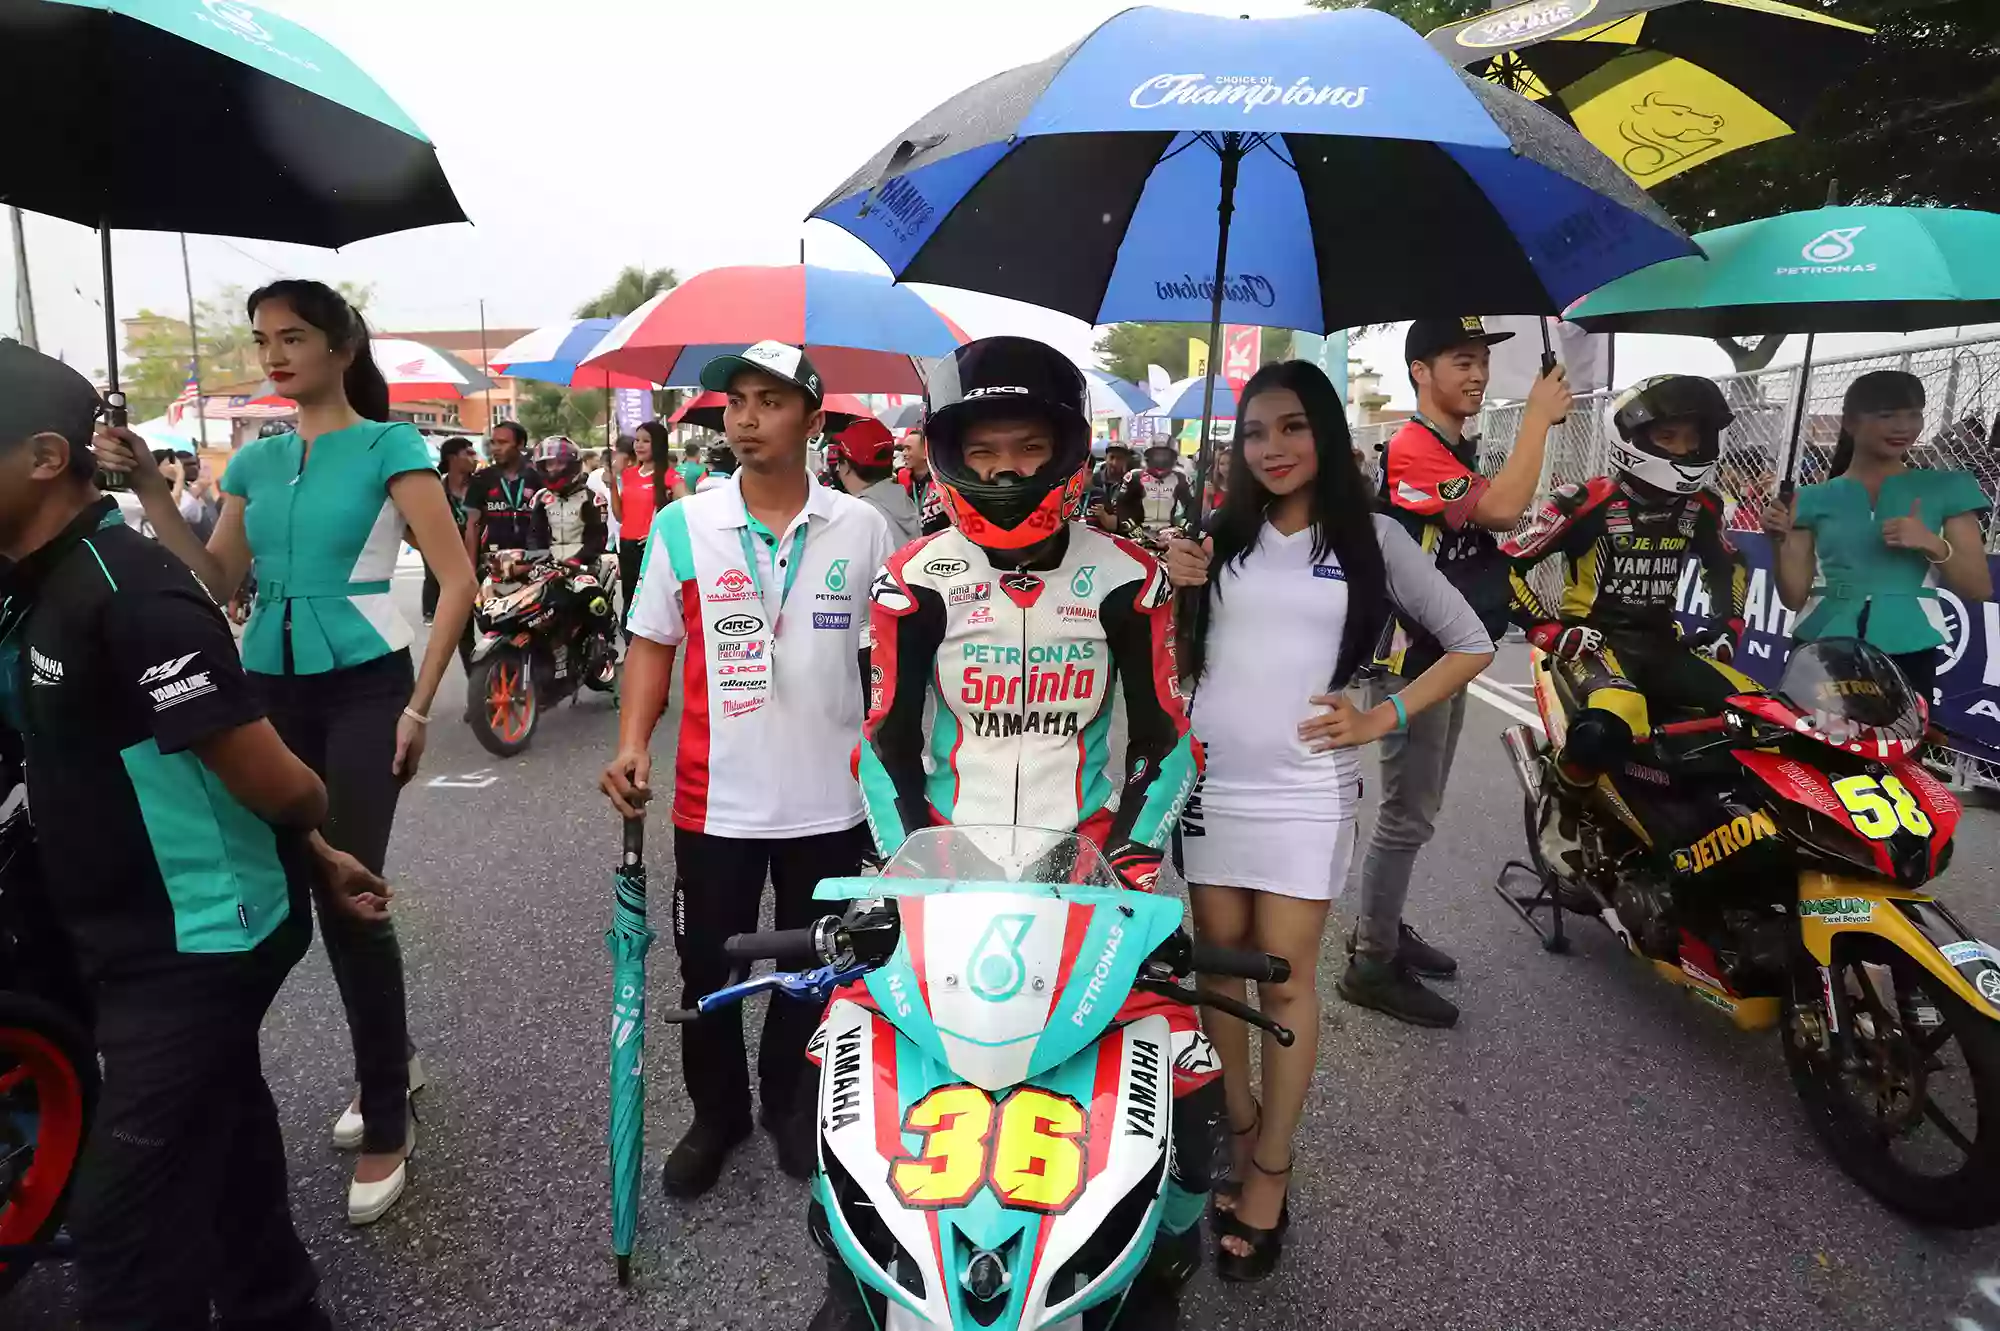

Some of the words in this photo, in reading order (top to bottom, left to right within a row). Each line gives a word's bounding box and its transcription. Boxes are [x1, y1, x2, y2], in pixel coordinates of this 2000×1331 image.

[1215, 76, 1257, 84] CHOICE
[1129, 73, 1369, 114] Champions
[1775, 263, 1877, 275] PETRONAS
[986, 385, 1029, 395] RCB
[930, 562, 961, 571] ARC
[1613, 556, 1678, 575] YAMAHA
[815, 593, 852, 601] PETRONAS
[951, 586, 970, 596] uma
[951, 592, 976, 602] racing
[1066, 606, 1097, 619] YAMAHA
[721, 620, 754, 630] ARC
[719, 643, 741, 651] uma
[963, 640, 1096, 666] PETRONAS
[719, 649, 747, 659] racing
[737, 665, 767, 673] RCB
[719, 679, 767, 687] aRacer
[961, 663, 1096, 712] Sprinta
[722, 697, 765, 714] Milwaukee
[969, 711, 1079, 738] YAMAHA
[1831, 774, 1933, 839] 58
[1690, 807, 1777, 874] JETRON
[1823, 915, 1842, 923] Excel
[1844, 915, 1871, 923] Beyond
[1071, 925, 1124, 1028] PETRONAS
[831, 1025, 862, 1133] YAMAHA
[1125, 1038, 1159, 1140] YAMAHA
[886, 1082, 1091, 1216] 36
